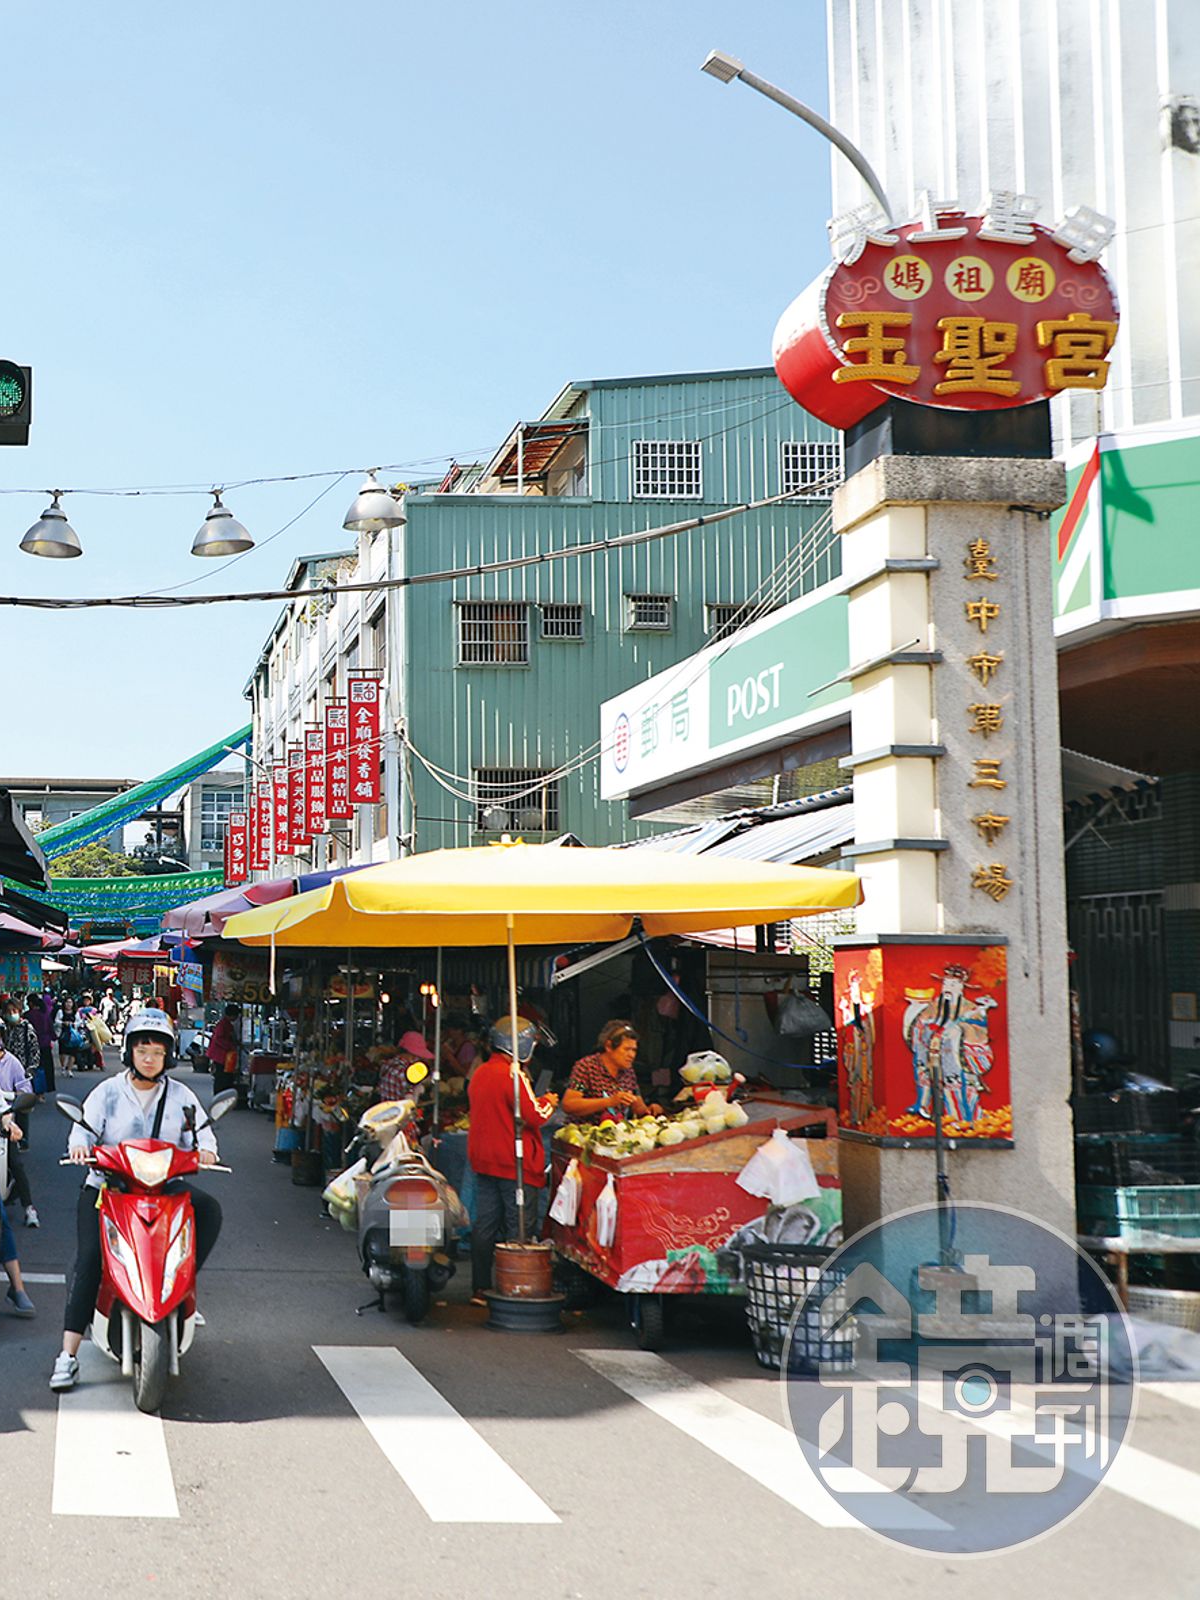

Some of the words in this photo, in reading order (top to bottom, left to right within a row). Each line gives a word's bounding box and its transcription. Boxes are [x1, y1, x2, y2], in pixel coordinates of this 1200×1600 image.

[890, 262, 1046, 297] 媽祖廟
[831, 312, 1120, 398] 玉聖宮
[640, 687, 689, 759] 郵局
[727, 662, 785, 728] POST
[963, 537, 1014, 902] 臺中市第三市場
